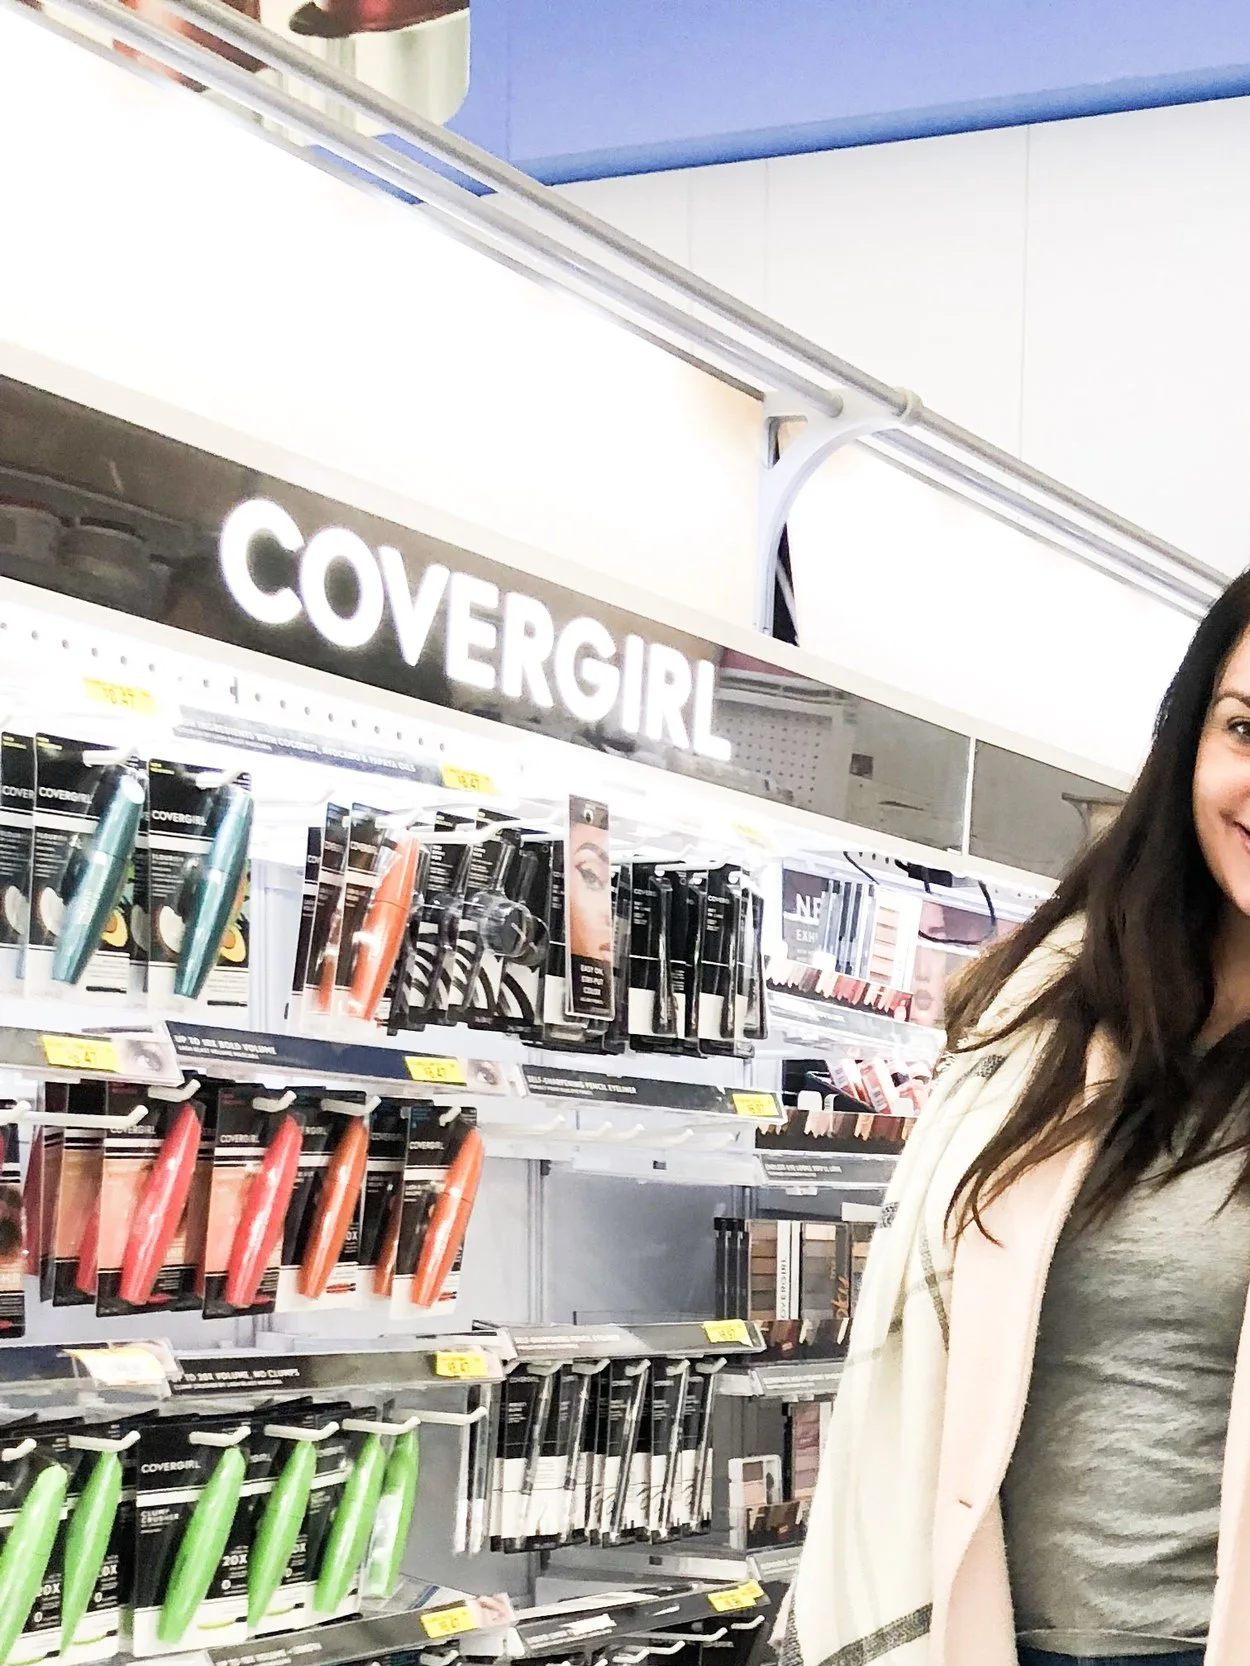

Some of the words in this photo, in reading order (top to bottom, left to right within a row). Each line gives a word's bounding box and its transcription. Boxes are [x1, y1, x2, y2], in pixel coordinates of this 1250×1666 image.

[218, 497, 733, 762] COVERGIRL
[39, 786, 92, 804] COVERGIRL
[152, 810, 207, 826] COVERGIRL
[141, 1459, 202, 1474] COVERGIRL
[221, 1554, 248, 1567] 20X
